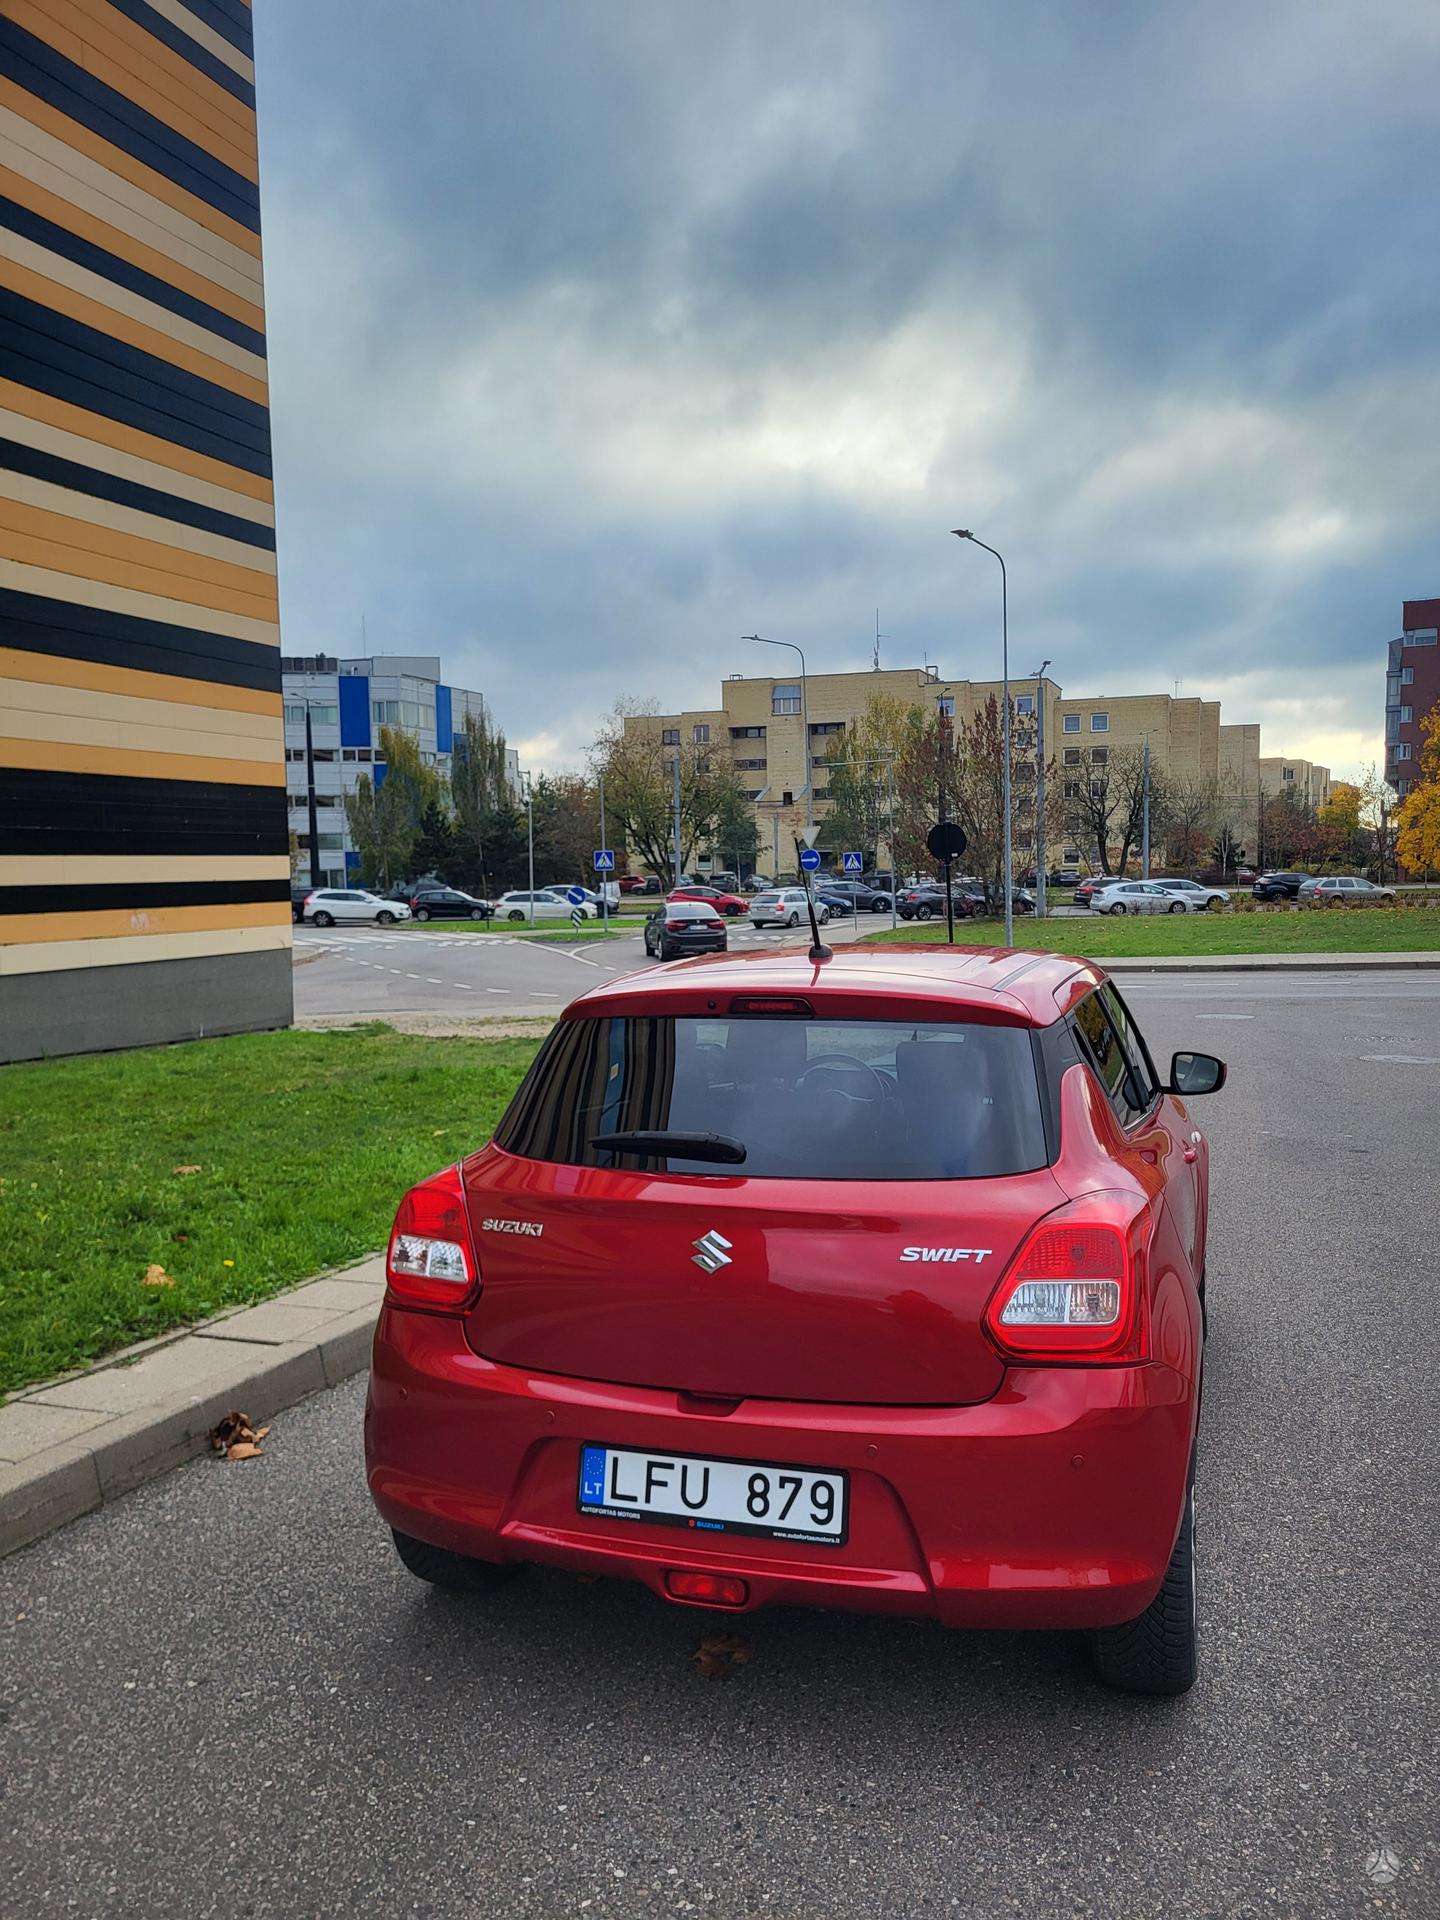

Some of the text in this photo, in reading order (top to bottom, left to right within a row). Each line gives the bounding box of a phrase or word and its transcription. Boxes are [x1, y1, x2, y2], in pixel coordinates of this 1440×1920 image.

[482, 1218, 544, 1237] SUZUKI
[899, 1247, 992, 1263] SWIFT
[584, 1482, 602, 1496] LT
[610, 1456, 835, 1526] LFU 879
[617, 1510, 641, 1520] MOTORS
